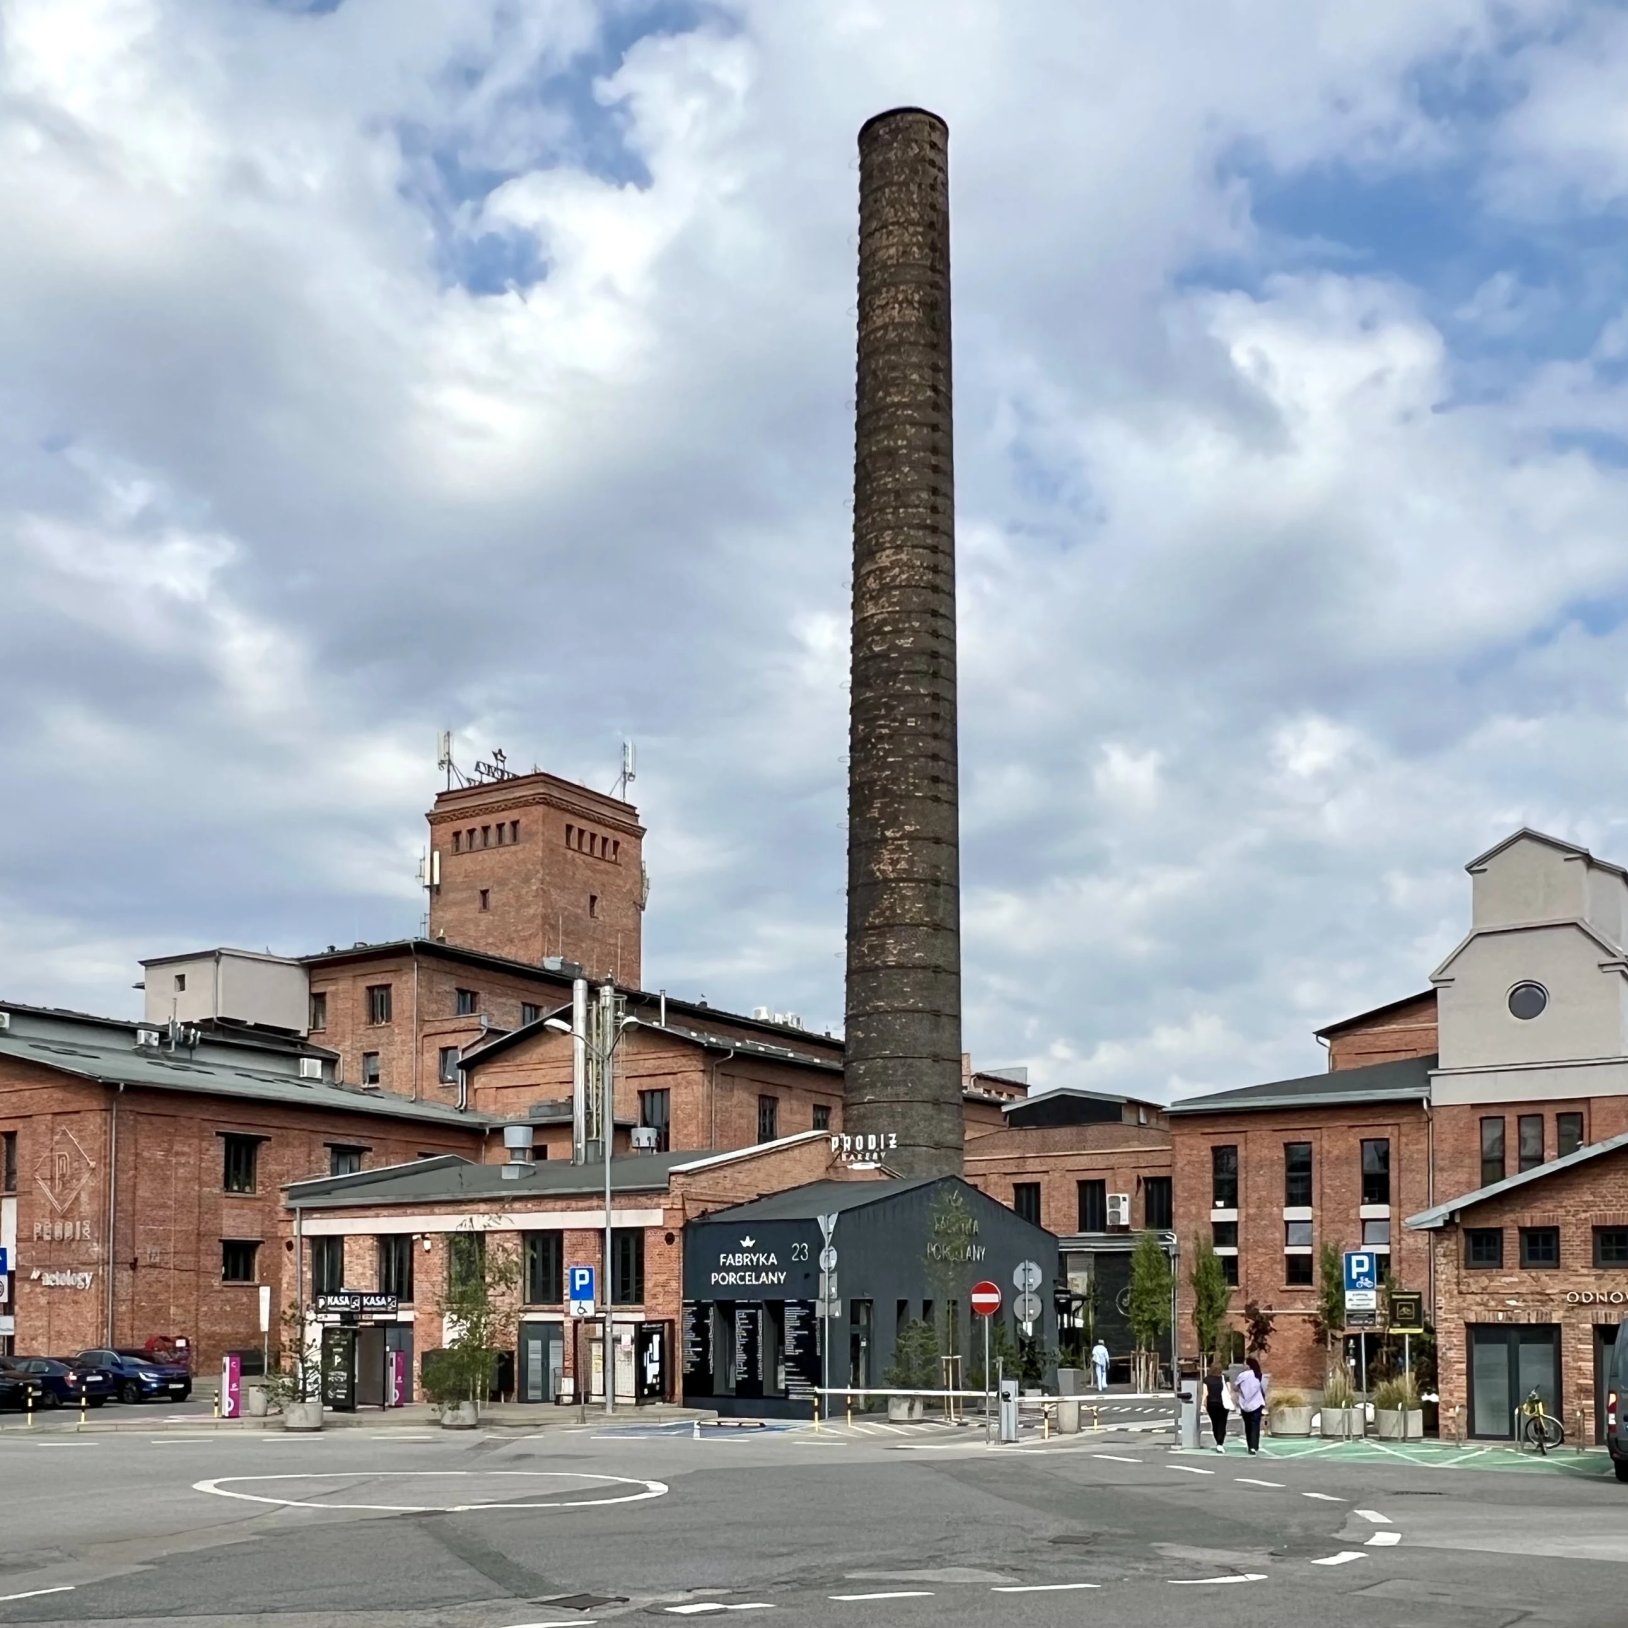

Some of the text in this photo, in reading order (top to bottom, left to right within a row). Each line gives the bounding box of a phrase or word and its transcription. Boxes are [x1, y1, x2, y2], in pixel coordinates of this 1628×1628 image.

[719, 1252, 778, 1266] FABRYKA
[791, 1242, 809, 1262] 23
[1351, 1255, 1370, 1280] P
[575, 1269, 590, 1291] P
[710, 1271, 787, 1285] PORCELANY
[327, 1295, 350, 1306] KASA
[362, 1295, 387, 1306] KASA
[1566, 1291, 1628, 1304] ODNO
